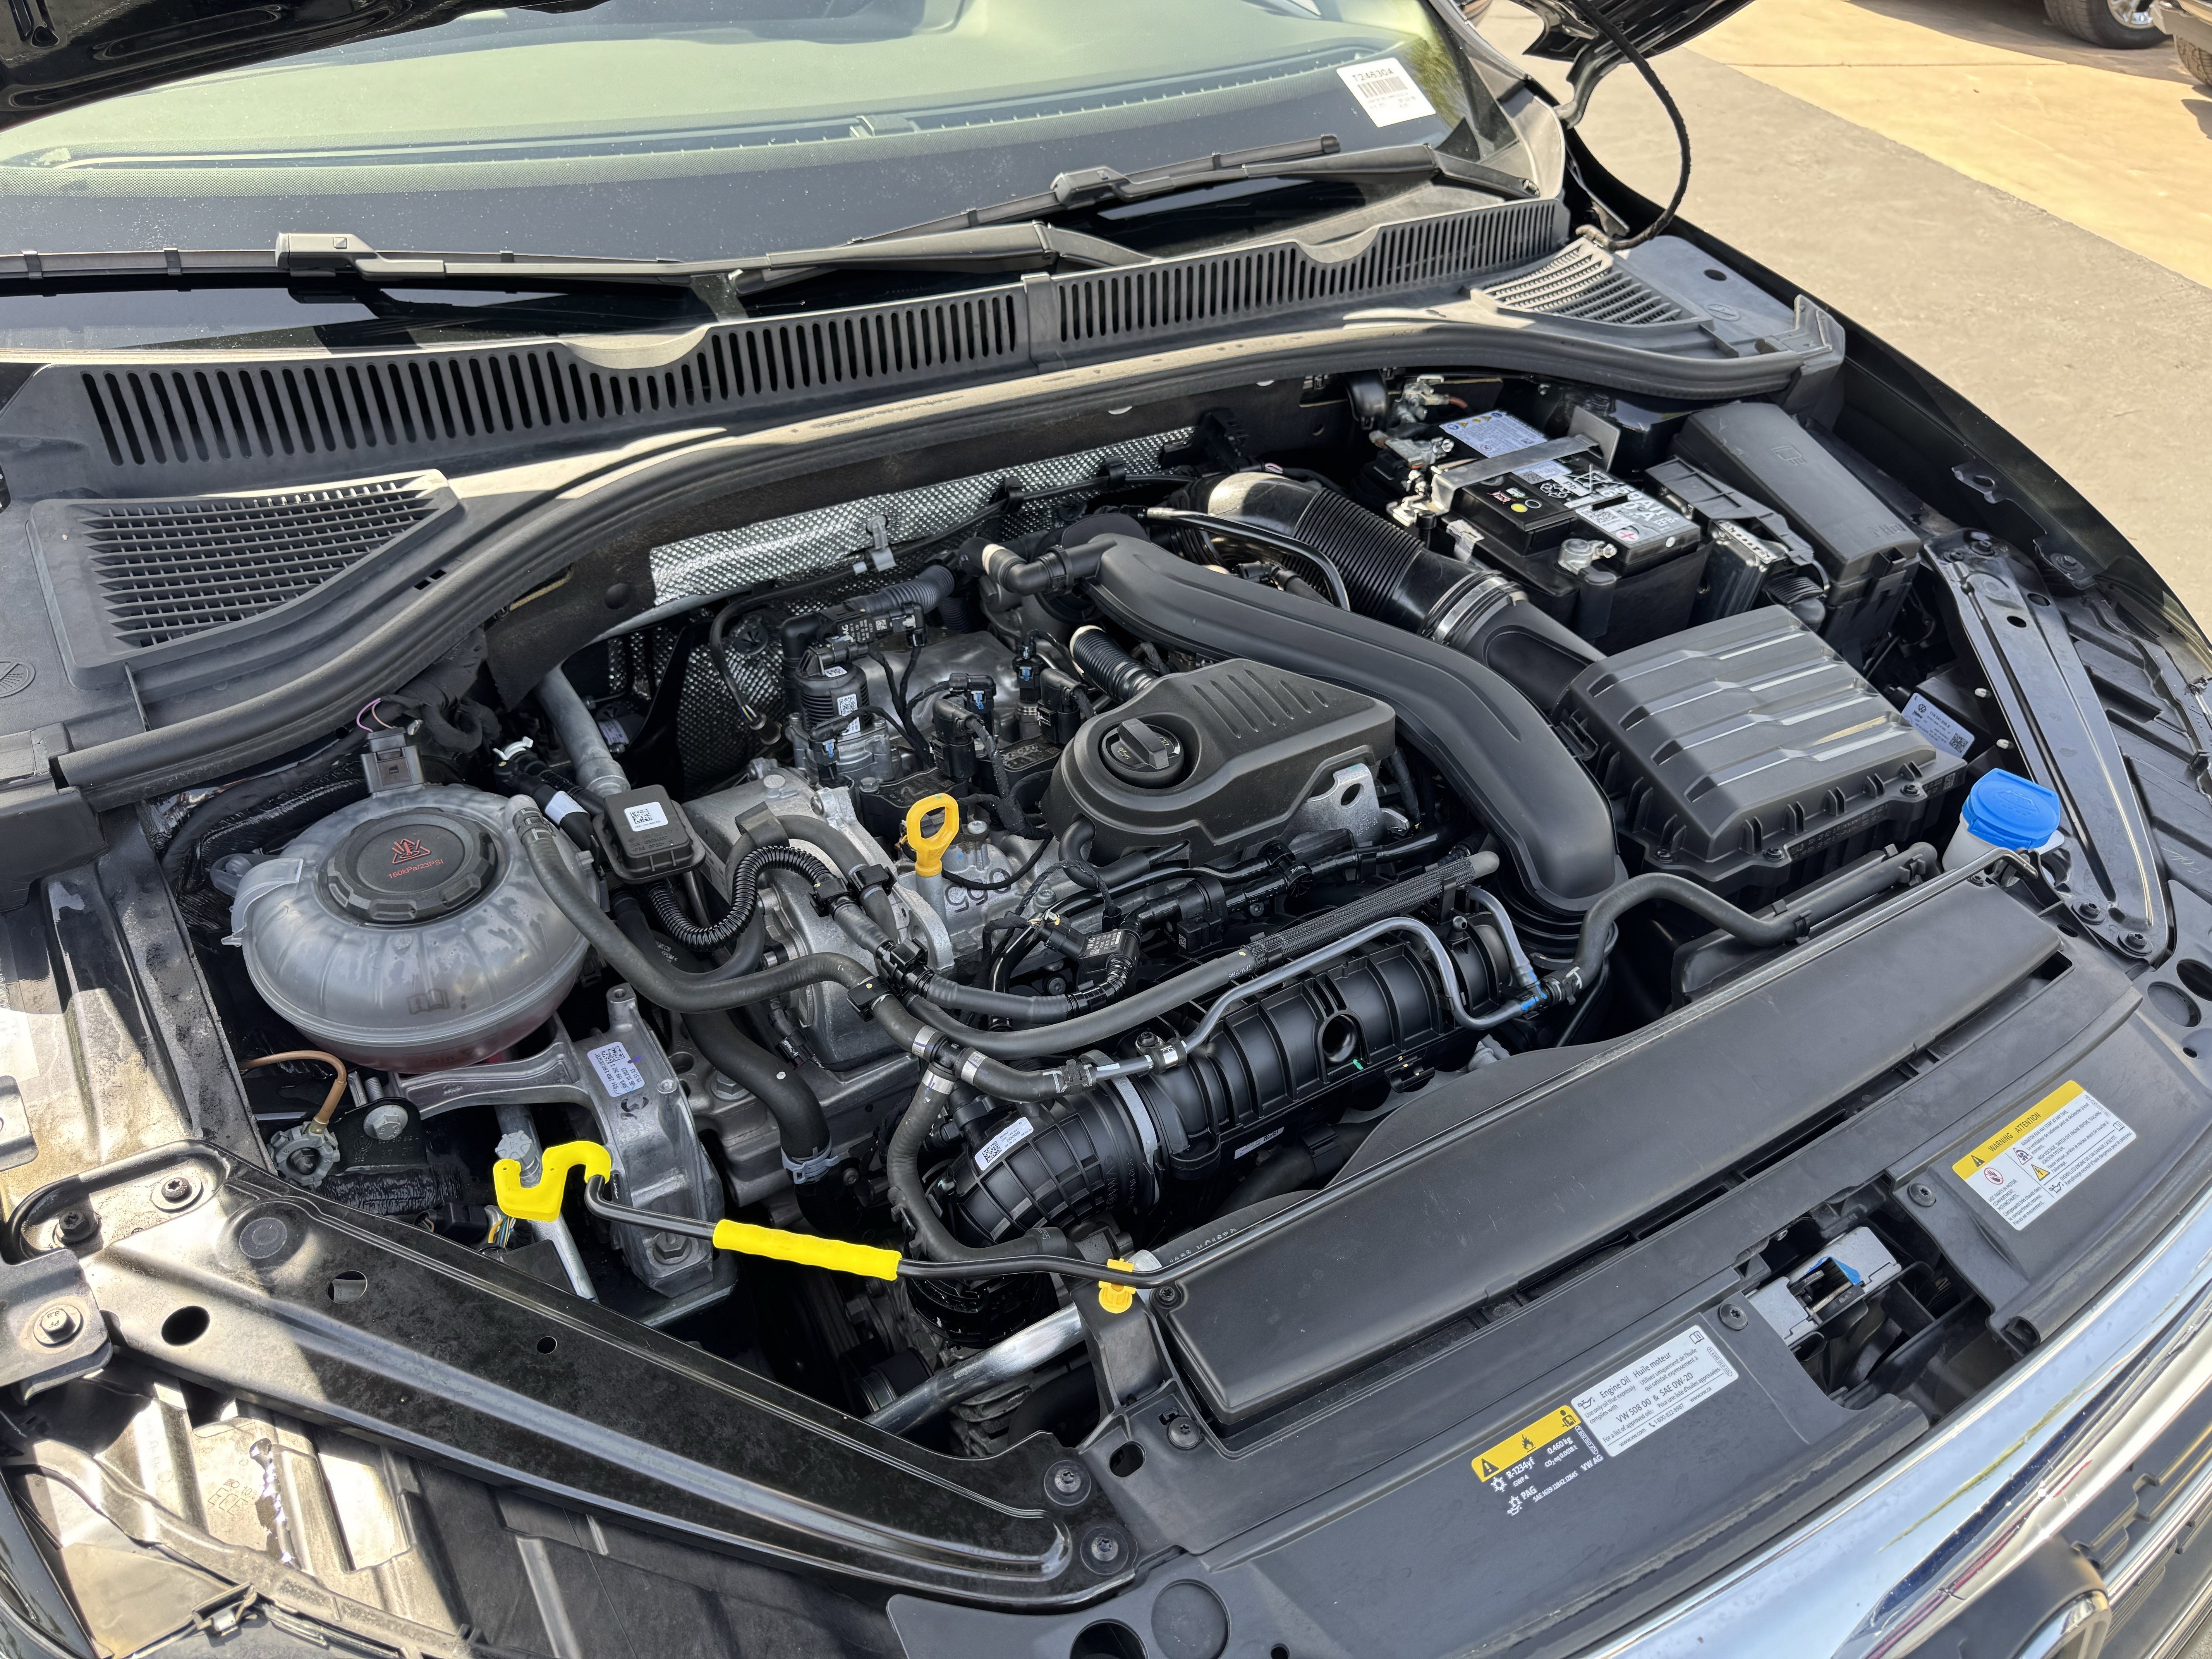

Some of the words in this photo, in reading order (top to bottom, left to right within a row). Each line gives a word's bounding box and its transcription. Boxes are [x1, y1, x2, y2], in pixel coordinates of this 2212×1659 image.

[1654, 516, 1680, 527] EFB+
[1987, 1132, 2014, 1152] WARNING
[2013, 1111, 2041, 1133] ATTENTION
[2020, 1134, 2035, 1146] RADIATOR
[2029, 1135, 2045, 1148] ventilateur
[2046, 1124, 2060, 1135] radiateur
[2055, 1137, 2067, 1147] SWITCH
[2069, 1126, 2081, 1135] ENGINE
[2078, 1120, 2090, 1128] BEFORE
[2088, 1110, 2102, 1121] TOUCHING
[2046, 1161, 2056, 1169] Haute
[2076, 1137, 2087, 1146] moteur
[2095, 1122, 2107, 1131] toucher
[2041, 1153, 2055, 1164] IGNITION
[2059, 1166, 2076, 1181] OVERFILLED
[2074, 1159, 2086, 1169] ENGINE
[2093, 1144, 2106, 1154] DAMAGE
[2064, 1171, 2083, 1186] Remplissage
[2079, 1163, 2092, 1173] excessif
[2097, 1146, 2113, 1159] dangereux
[1994, 1188, 2004, 1197] PARTS
[2006, 1179, 2017, 1188] MOTOR
[1997, 1200, 2010, 1211] MOVING
[2002, 1202, 2022, 1217] Composants
[2023, 1190, 2035, 1200] chauds
[2010, 1201, 2033, 1219] compartiment
[1632, 1364, 1650, 1378] Huile
[1649, 1352, 1672, 1368] moteur
[1639, 1373, 1656, 1385] Utilisez
[1654, 1358, 1681, 1377] uniquement
[1644, 1384, 1653, 1392] qui
[1650, 1374, 1668, 1386] satisfait
[1666, 1357, 1696, 1378] expressément
[1599, 1381, 1623, 1400] Engine
[1619, 1376, 1631, 1386] Oil
[1615, 1411, 1630, 1423] VW
[1628, 1403, 1643, 1415] 508
[1640, 1398, 1652, 1408] 00
[1658, 1384, 1673, 1396] SAE
[1671, 1371, 1694, 1389] 0W-20
[1657, 1399, 1668, 1408] Pour
[1674, 1389, 1685, 1398] liste
[1584, 1410, 1594, 1418] Use
[1592, 1404, 1604, 1414] only
[1607, 1395, 1617, 1404] that
[1616, 1384, 1637, 1400] expressly
[1588, 1409, 1609, 1425] complies
[1606, 1403, 1618, 1413] with
[1618, 1427, 1646, 1447] www.vw.com
[1689, 1386, 1712, 1402] www.vw.ca
[1602, 1434, 1612, 1443] For
[1624, 1413, 1646, 1430] approved
[1546, 1440, 1565, 1455] 0.460
[1562, 1435, 1573, 1446] kg
[1504, 1456, 1537, 1481] R-1234yf
[1553, 1455, 1562, 1463] eq
[1579, 1460, 1594, 1472] VW
[1591, 1453, 1604, 1464] AG
[1511, 1476, 1526, 1487] GWP
[1519, 1484, 1538, 1500] PAG
[1532, 1492, 1544, 1502] SAE
[1551, 1478, 1566, 1490] J2842
[1563, 1470, 1578, 1482] J2845
[208, 1487, 249, 1516] ECE
